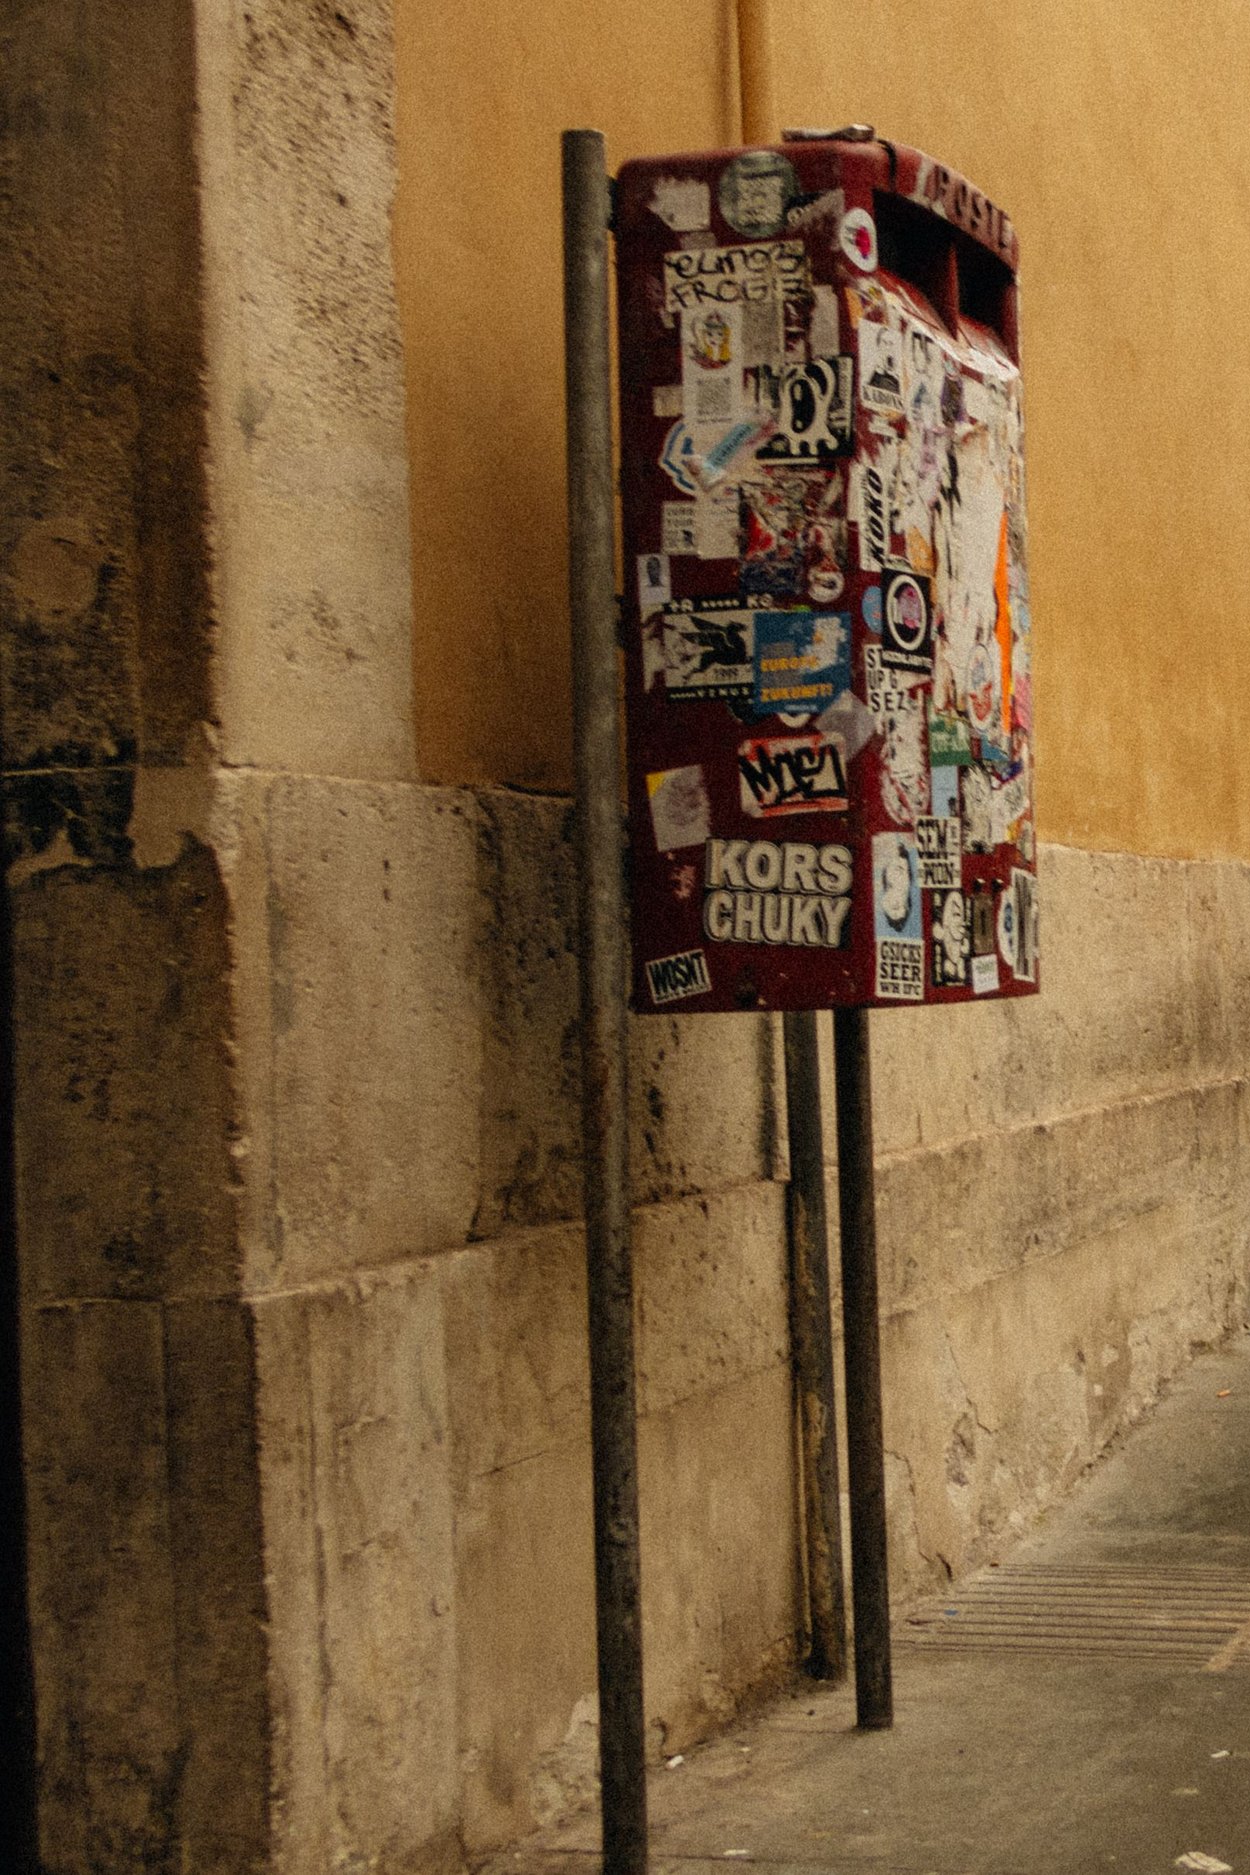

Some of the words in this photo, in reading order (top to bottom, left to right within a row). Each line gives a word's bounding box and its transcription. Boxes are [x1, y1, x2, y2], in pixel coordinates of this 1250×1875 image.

[704, 837, 853, 896] KORS
[703, 889, 852, 948] CHUKY
[880, 962, 922, 983] SEER
